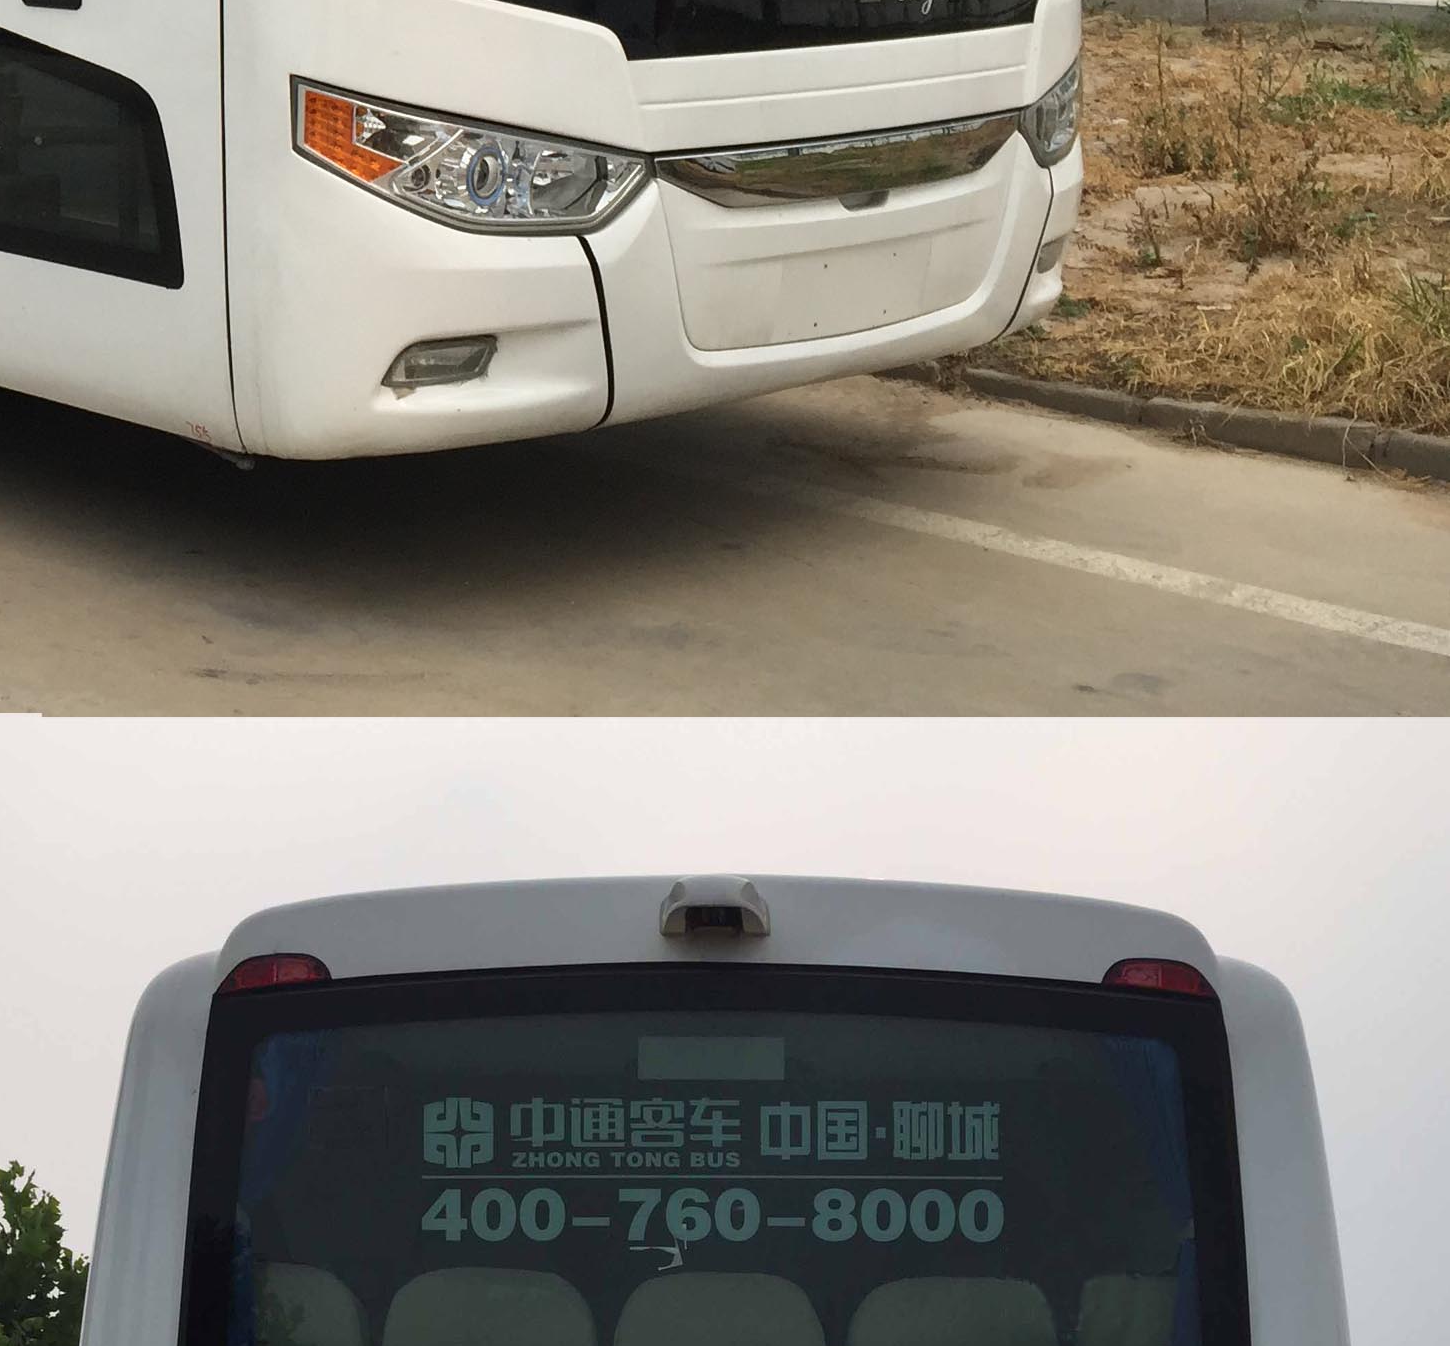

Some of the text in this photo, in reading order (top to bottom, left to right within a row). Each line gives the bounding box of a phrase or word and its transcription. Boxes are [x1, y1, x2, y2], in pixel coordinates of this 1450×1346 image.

[509, 1097, 1000, 1161] 中通客车 中国·聊城
[512, 1152, 742, 1168] ZHONG TONG BUS
[422, 1187, 1004, 1243] 400-760-8000
